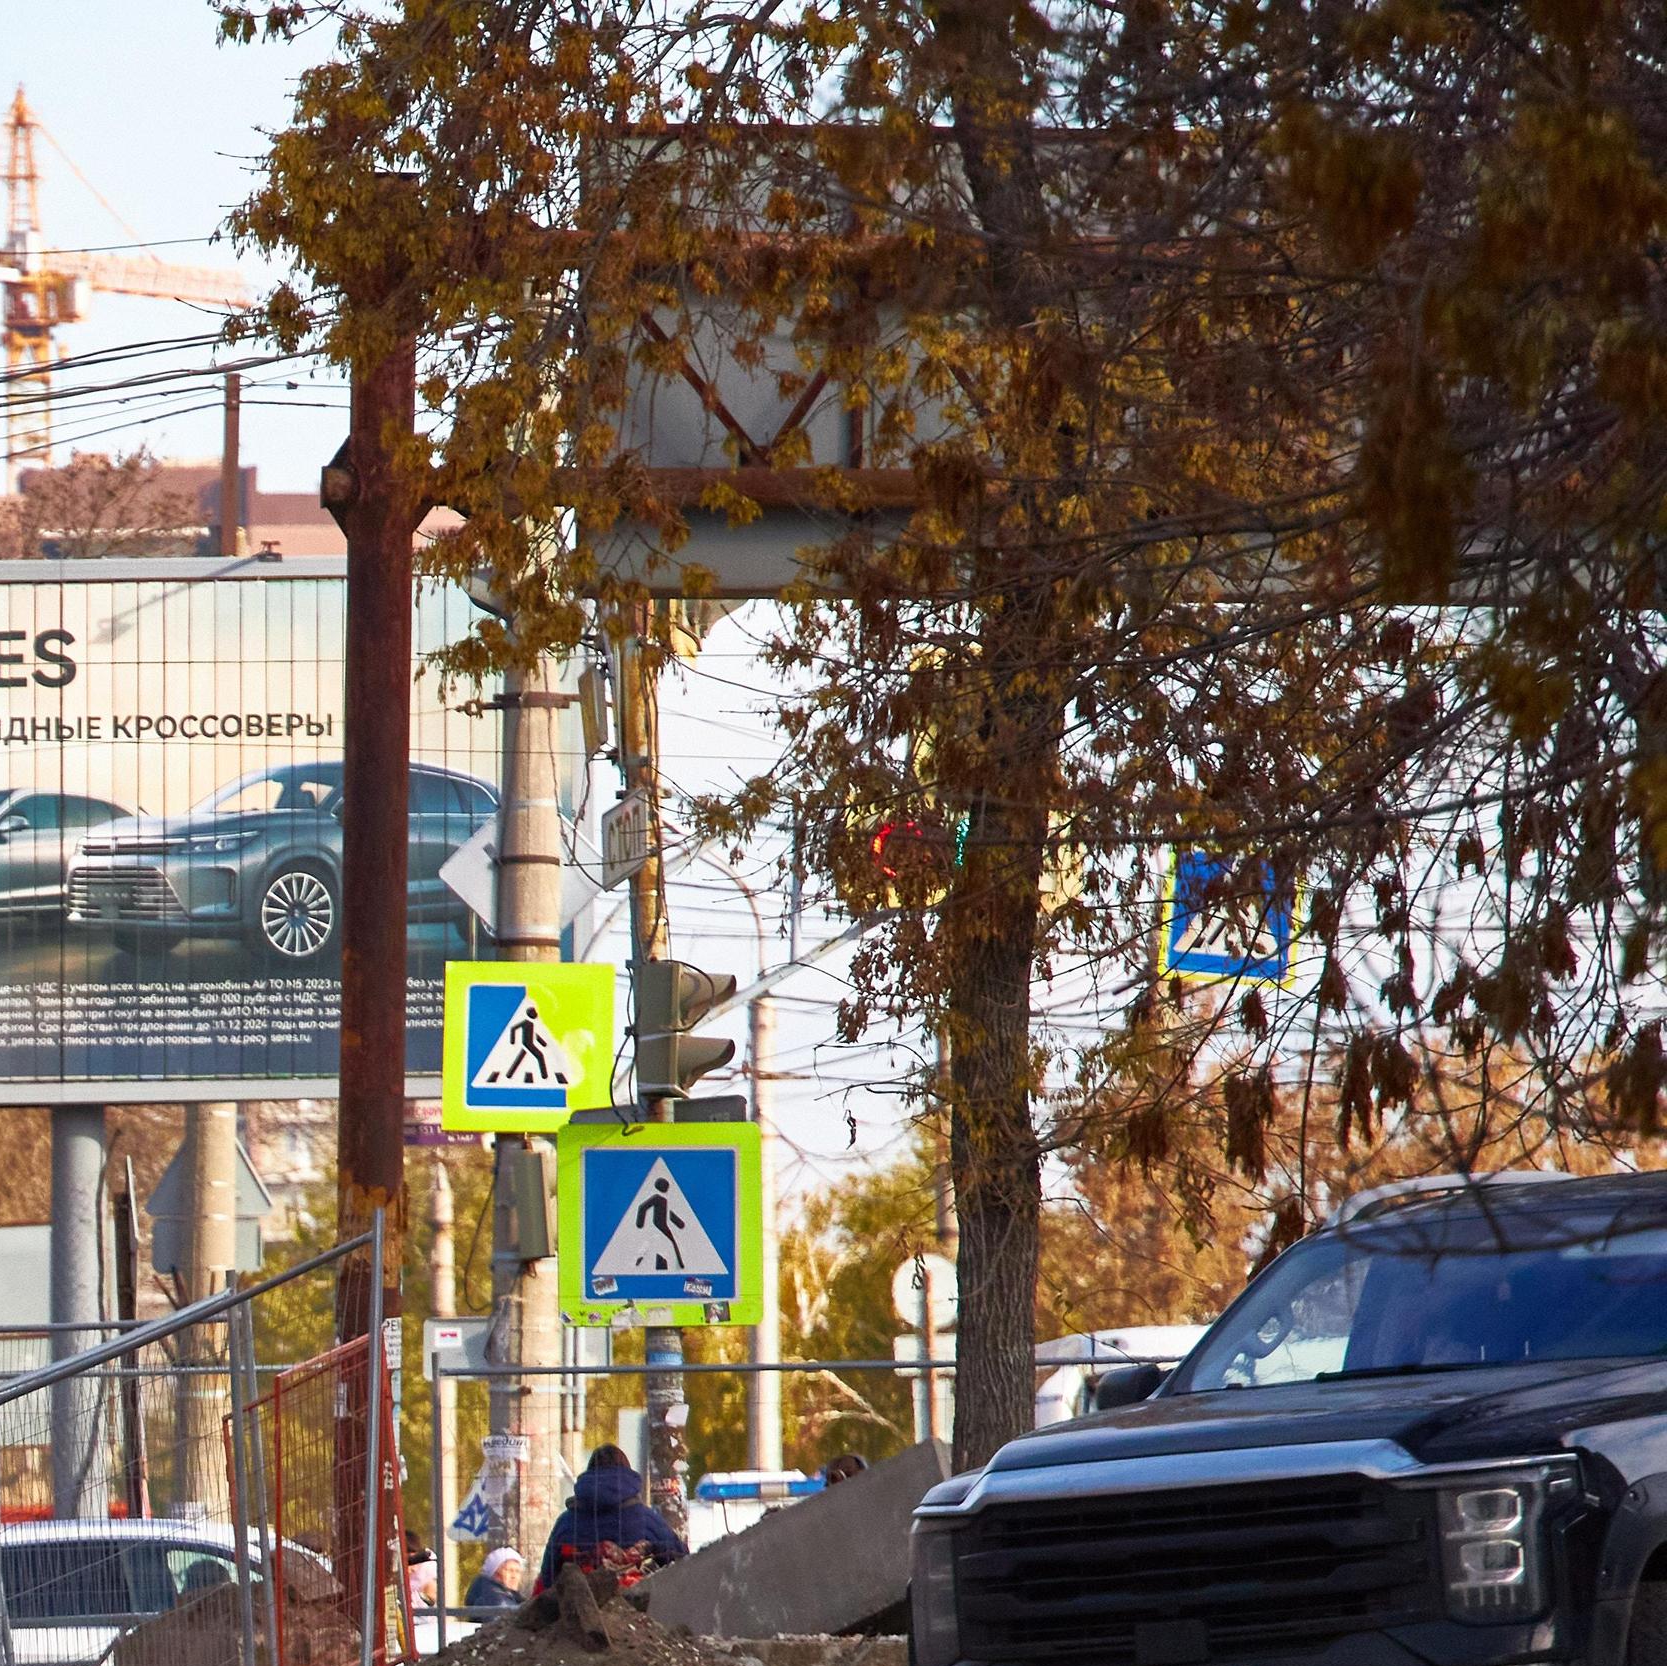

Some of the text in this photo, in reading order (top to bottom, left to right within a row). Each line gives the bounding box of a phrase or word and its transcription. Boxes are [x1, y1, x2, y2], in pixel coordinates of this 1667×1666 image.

[112, 713, 334, 740] КРОССОВЕРЫ
[608, 804, 641, 871] СТОП
[305, 978, 331, 989] 2023
